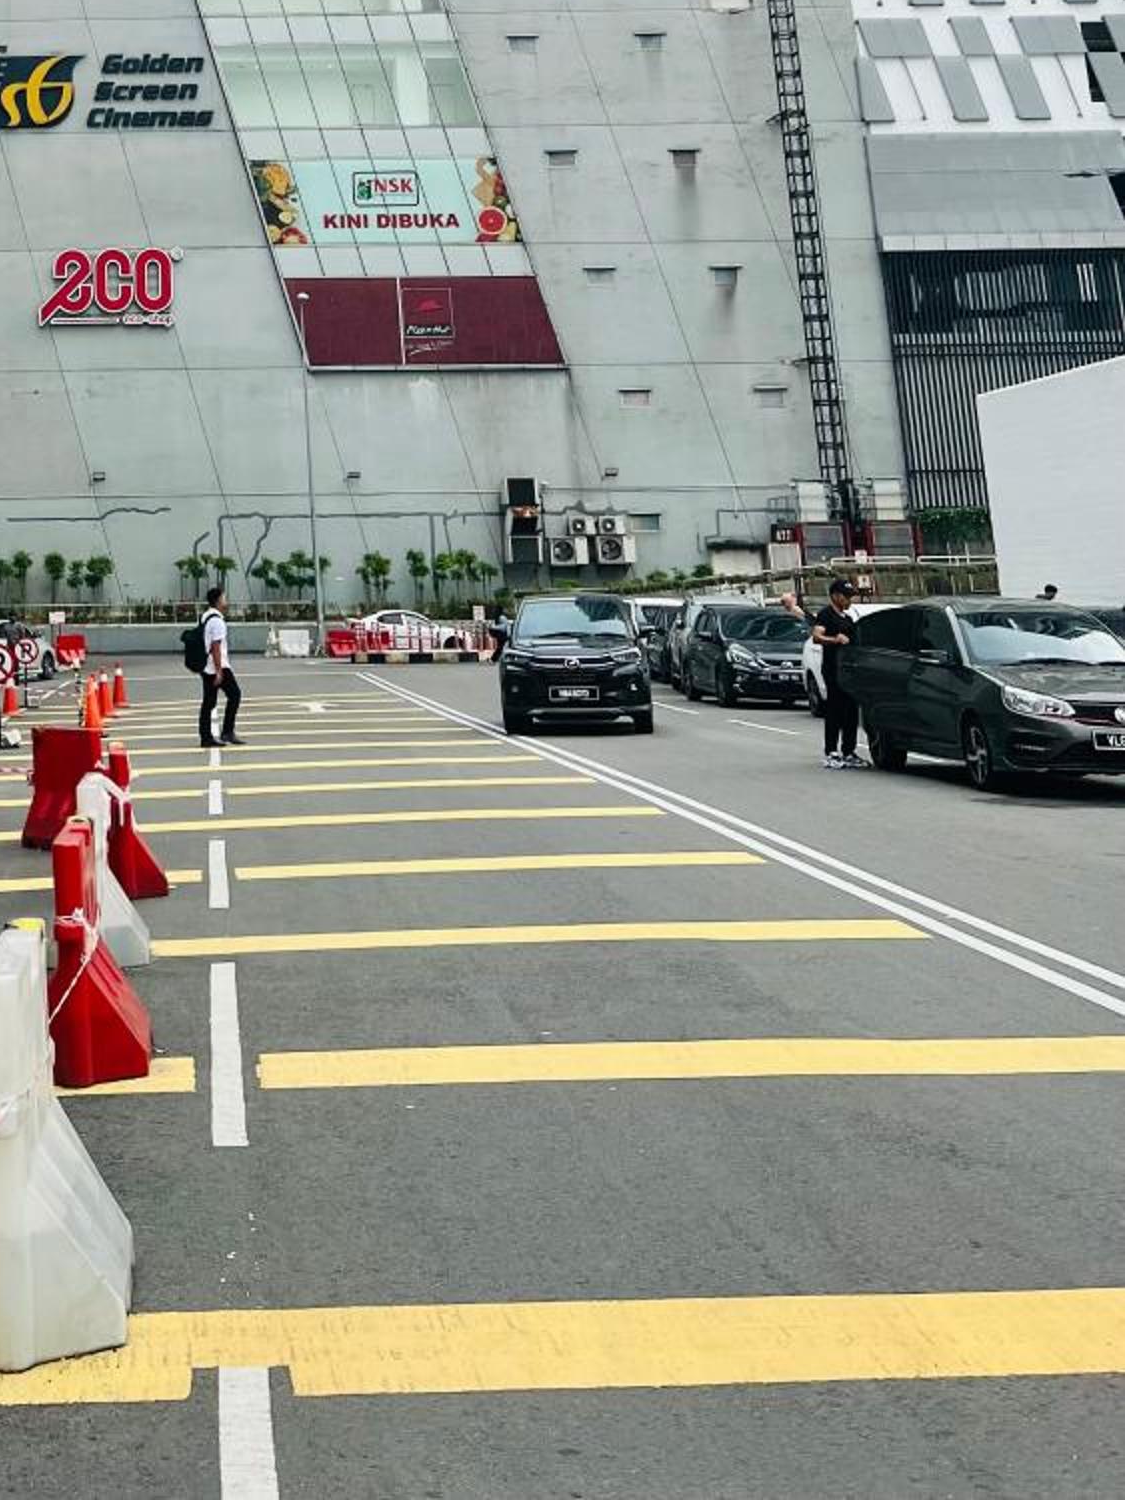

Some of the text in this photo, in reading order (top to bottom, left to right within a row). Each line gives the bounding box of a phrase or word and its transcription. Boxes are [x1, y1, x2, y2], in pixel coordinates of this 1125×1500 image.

[101, 53, 204, 75] Golden
[94, 81, 198, 102] Screen
[86, 107, 215, 129] Cinemas
[374, 179, 414, 194] NSK
[323, 213, 460, 229] KINI DIBUKA
